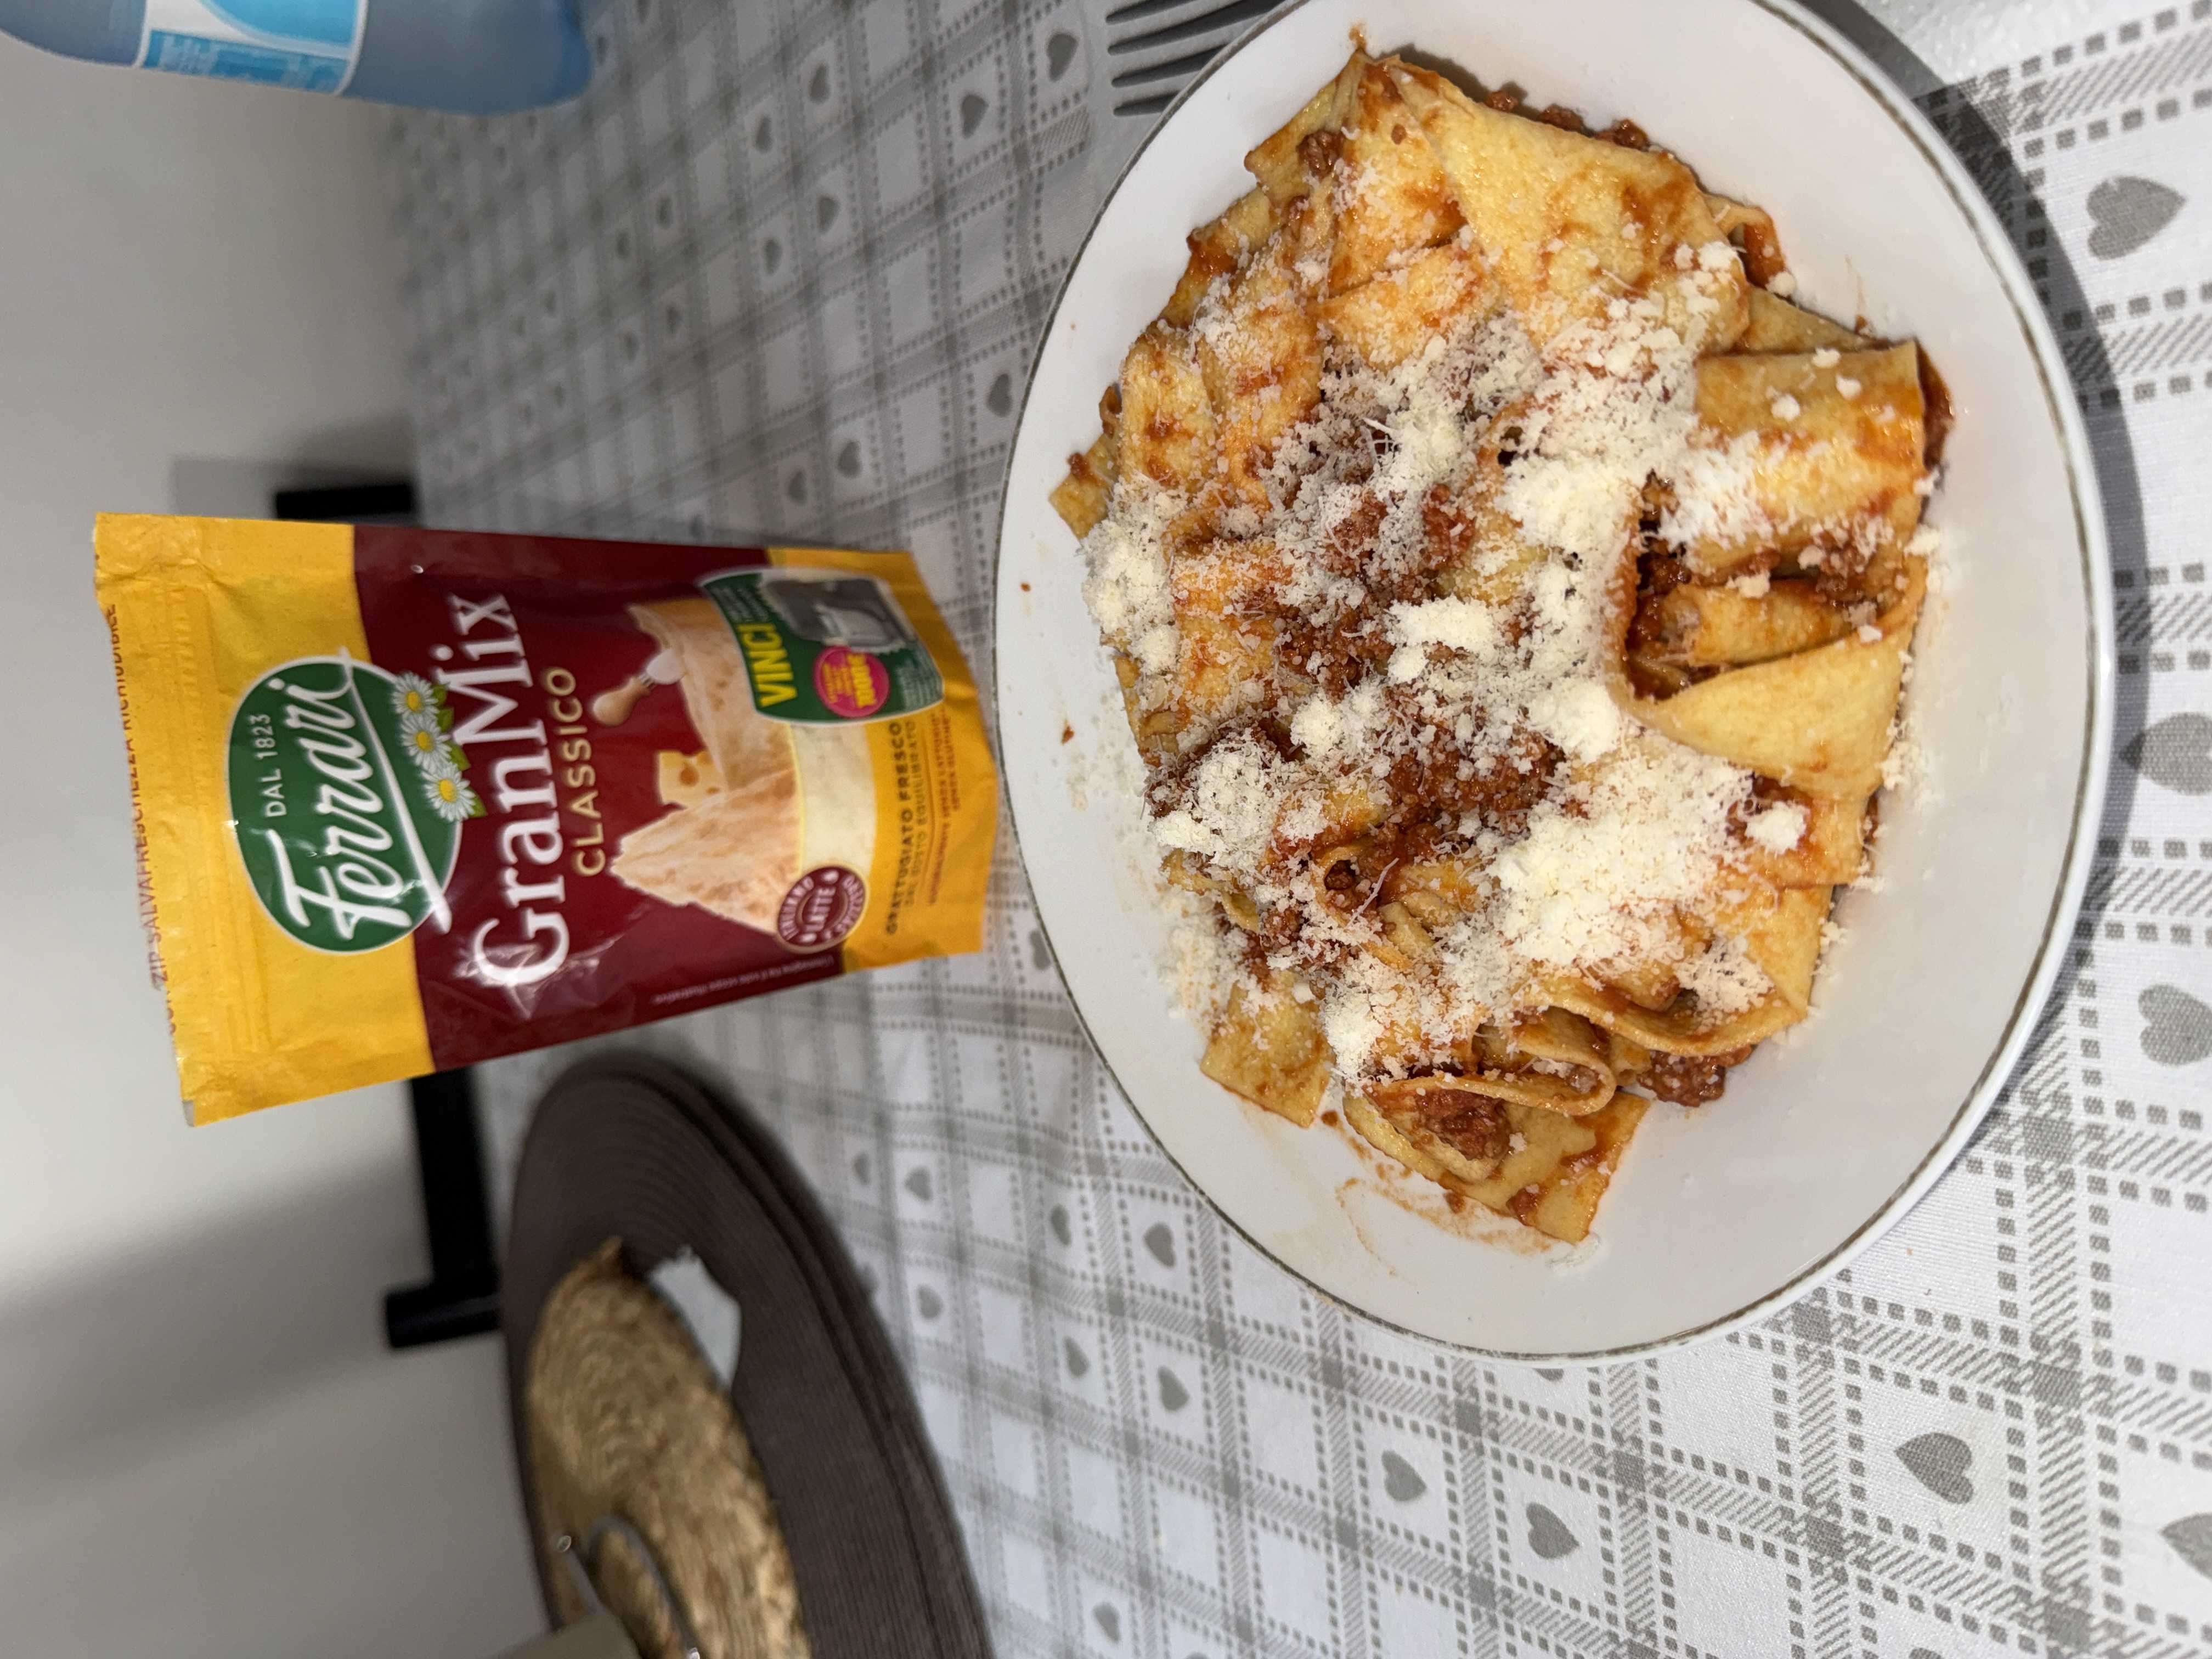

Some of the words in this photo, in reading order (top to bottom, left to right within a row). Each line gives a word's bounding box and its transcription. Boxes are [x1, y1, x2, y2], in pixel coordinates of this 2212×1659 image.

[737, 623, 797, 706] VINCI
[250, 714, 278, 759] 1823
[546, 667, 606, 876] CLASSICO
[888, 721, 911, 800] FRESCO
[261, 768, 287, 816] DAL
[266, 647, 452, 939] Ferrari
[433, 593, 571, 987] GranMix
[803, 886, 836, 931] LATTE
[885, 807, 913, 934] GRATTUGIATO
